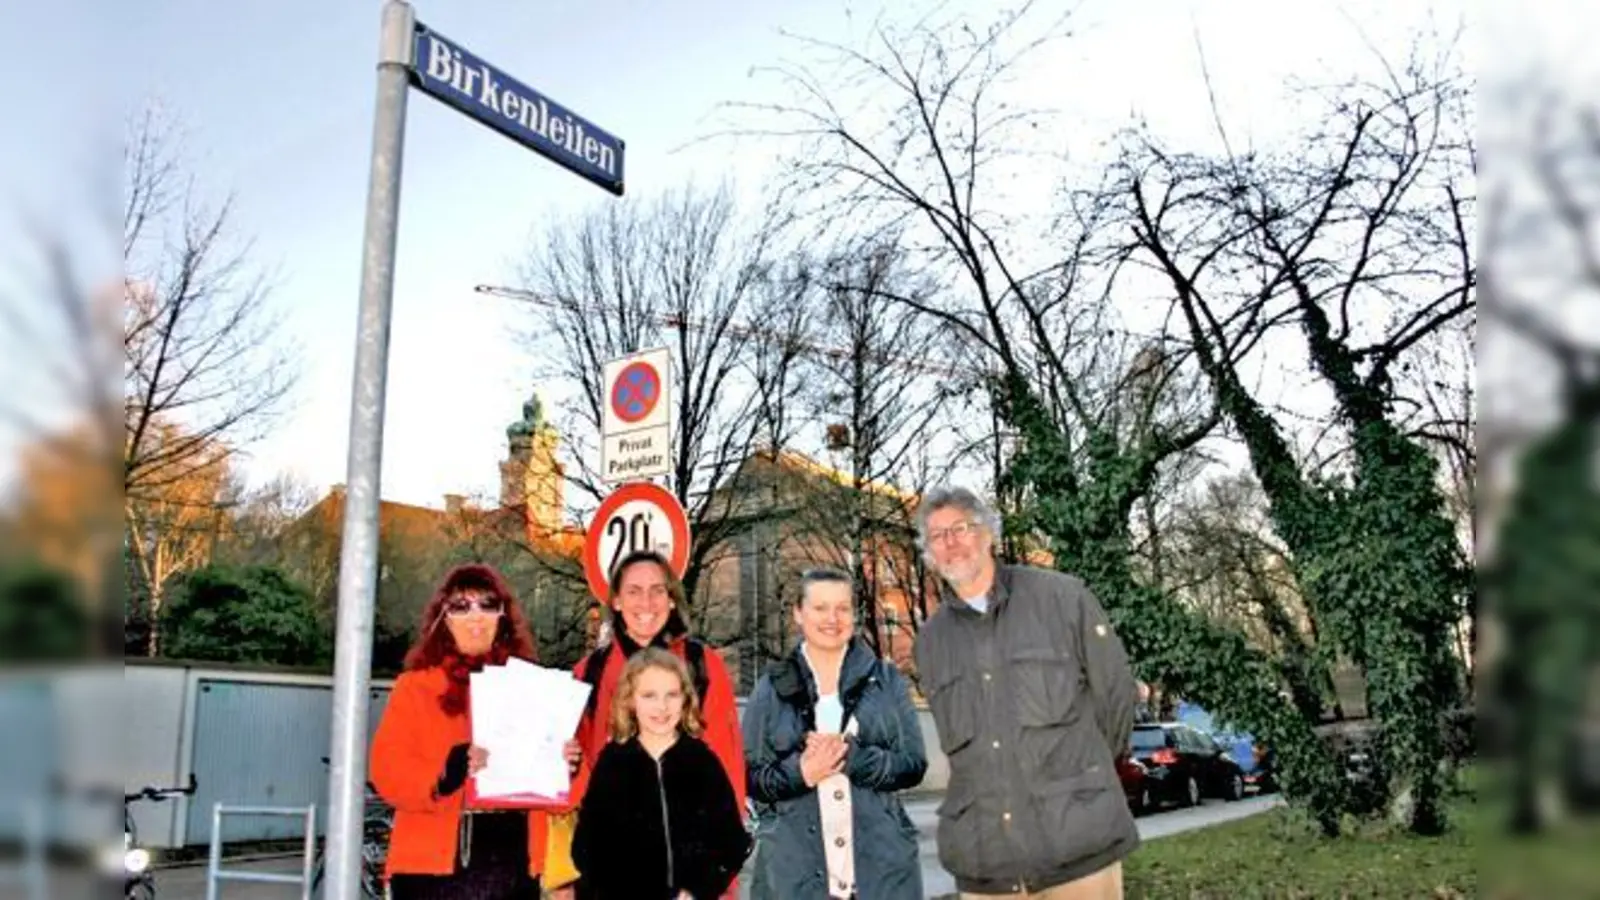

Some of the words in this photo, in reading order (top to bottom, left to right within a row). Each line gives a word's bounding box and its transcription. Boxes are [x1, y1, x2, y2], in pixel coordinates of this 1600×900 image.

[426, 35, 616, 176] Birkenleiten
[618, 436, 652, 453] Privat
[609, 454, 663, 474] Parkplatz
